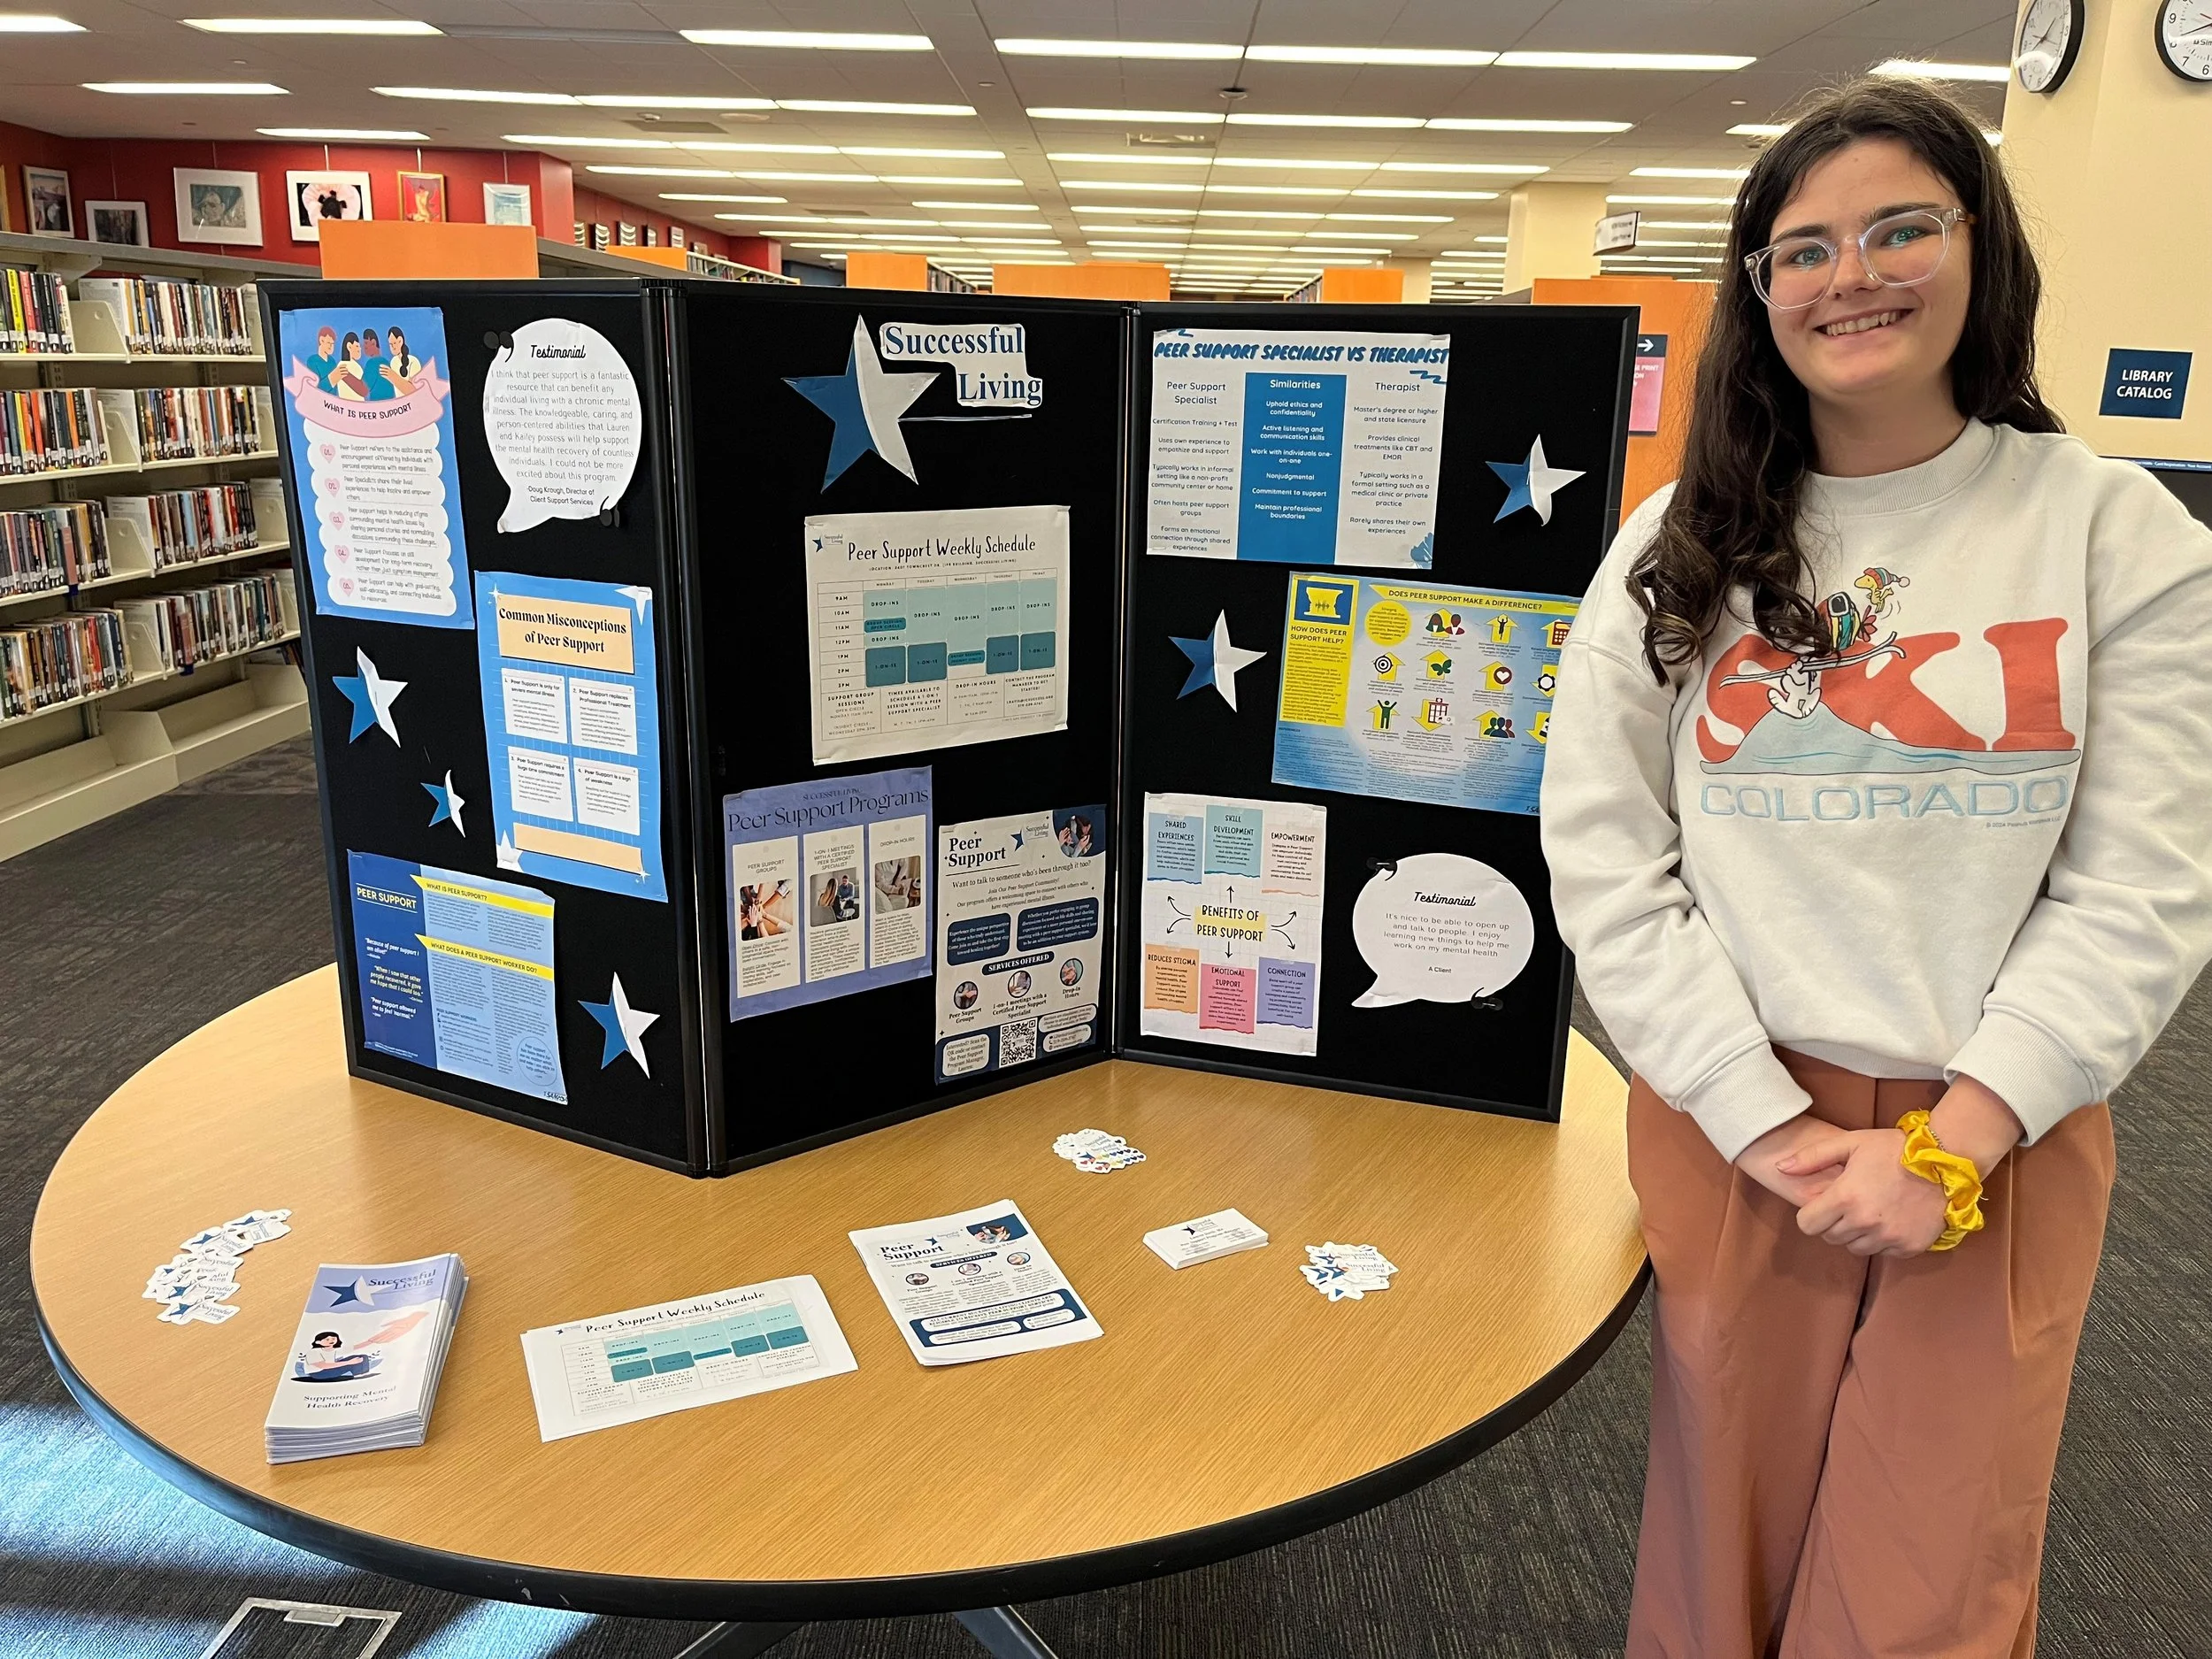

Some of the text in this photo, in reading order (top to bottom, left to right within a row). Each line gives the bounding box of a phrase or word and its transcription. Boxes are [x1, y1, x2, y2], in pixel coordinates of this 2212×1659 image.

[2169, 13, 2177, 23] 9
[2182, 57, 2190, 66] 7
[2202, 65, 2209, 75] 6
[885, 326, 1024, 355] Successful
[531, 345, 587, 358] Testimonial
[1154, 342, 1449, 364] PEER SUPPORT SPECIALIST VS THERAPIST
[551, 371, 578, 380] support
[2122, 370, 2173, 382] LIBRARY
[958, 373, 1041, 404] Living
[1167, 381, 1226, 392] Peer Support
[1270, 380, 1320, 388] Similarities
[1375, 382, 1420, 393] Therapist
[2116, 386, 2172, 400] CATALOG
[1175, 396, 1217, 405] Specialist
[324, 400, 344, 415] WHAT
[380, 403, 411, 419] SUPPORT
[849, 534, 1035, 563] Peer Support Weekly Schedule
[1493, 600, 1542, 610] DIFFERENCE?
[499, 608, 626, 634] Common Misconceptions
[525, 631, 604, 653] of Peer Support
[1695, 617, 2076, 762] SKI
[1700, 774, 2069, 822] COLORADO
[728, 789, 929, 832] Peer Support Programs
[1165, 820, 1187, 829] SHARED
[1213, 826, 1254, 836] DEVELOPMENT
[1158, 832, 1194, 841] EXPERIENCES
[1271, 832, 1315, 843] EMPOWERMENT
[949, 838, 982, 852] Peer
[949, 848, 1006, 868] Support
[1052, 863, 1073, 874] through
[357, 887, 416, 909] PEER SUPPORT
[461, 891, 487, 901] SUPPORT?
[1414, 892, 1476, 907] Testimonial
[1202, 904, 1259, 922] BENEFITS OF
[1197, 924, 1263, 942] PEER SUPPORT
[446, 946, 460, 955] DOES
[479, 954, 502, 964] SUPPORT
[503, 960, 525, 970] WORKER
[988, 954, 1049, 972] SERVICES OFFERED
[1148, 954, 1196, 966] REDUCES STIGMA
[1211, 966, 1245, 977] EMOTIONAL
[1267, 967, 1306, 978] CONNECTION
[1216, 979, 1240, 988] SUPPORT
[879, 1243, 915, 1254] Peer
[884, 1245, 945, 1261] Support
[368, 1269, 436, 1286] Successful
[394, 1278, 434, 1289] Living
[586, 1292, 765, 1333] Peer Support Weekly Schedule
[303, 1386, 396, 1402] Supporting Mental
[345, 1395, 388, 1407] Recovery
